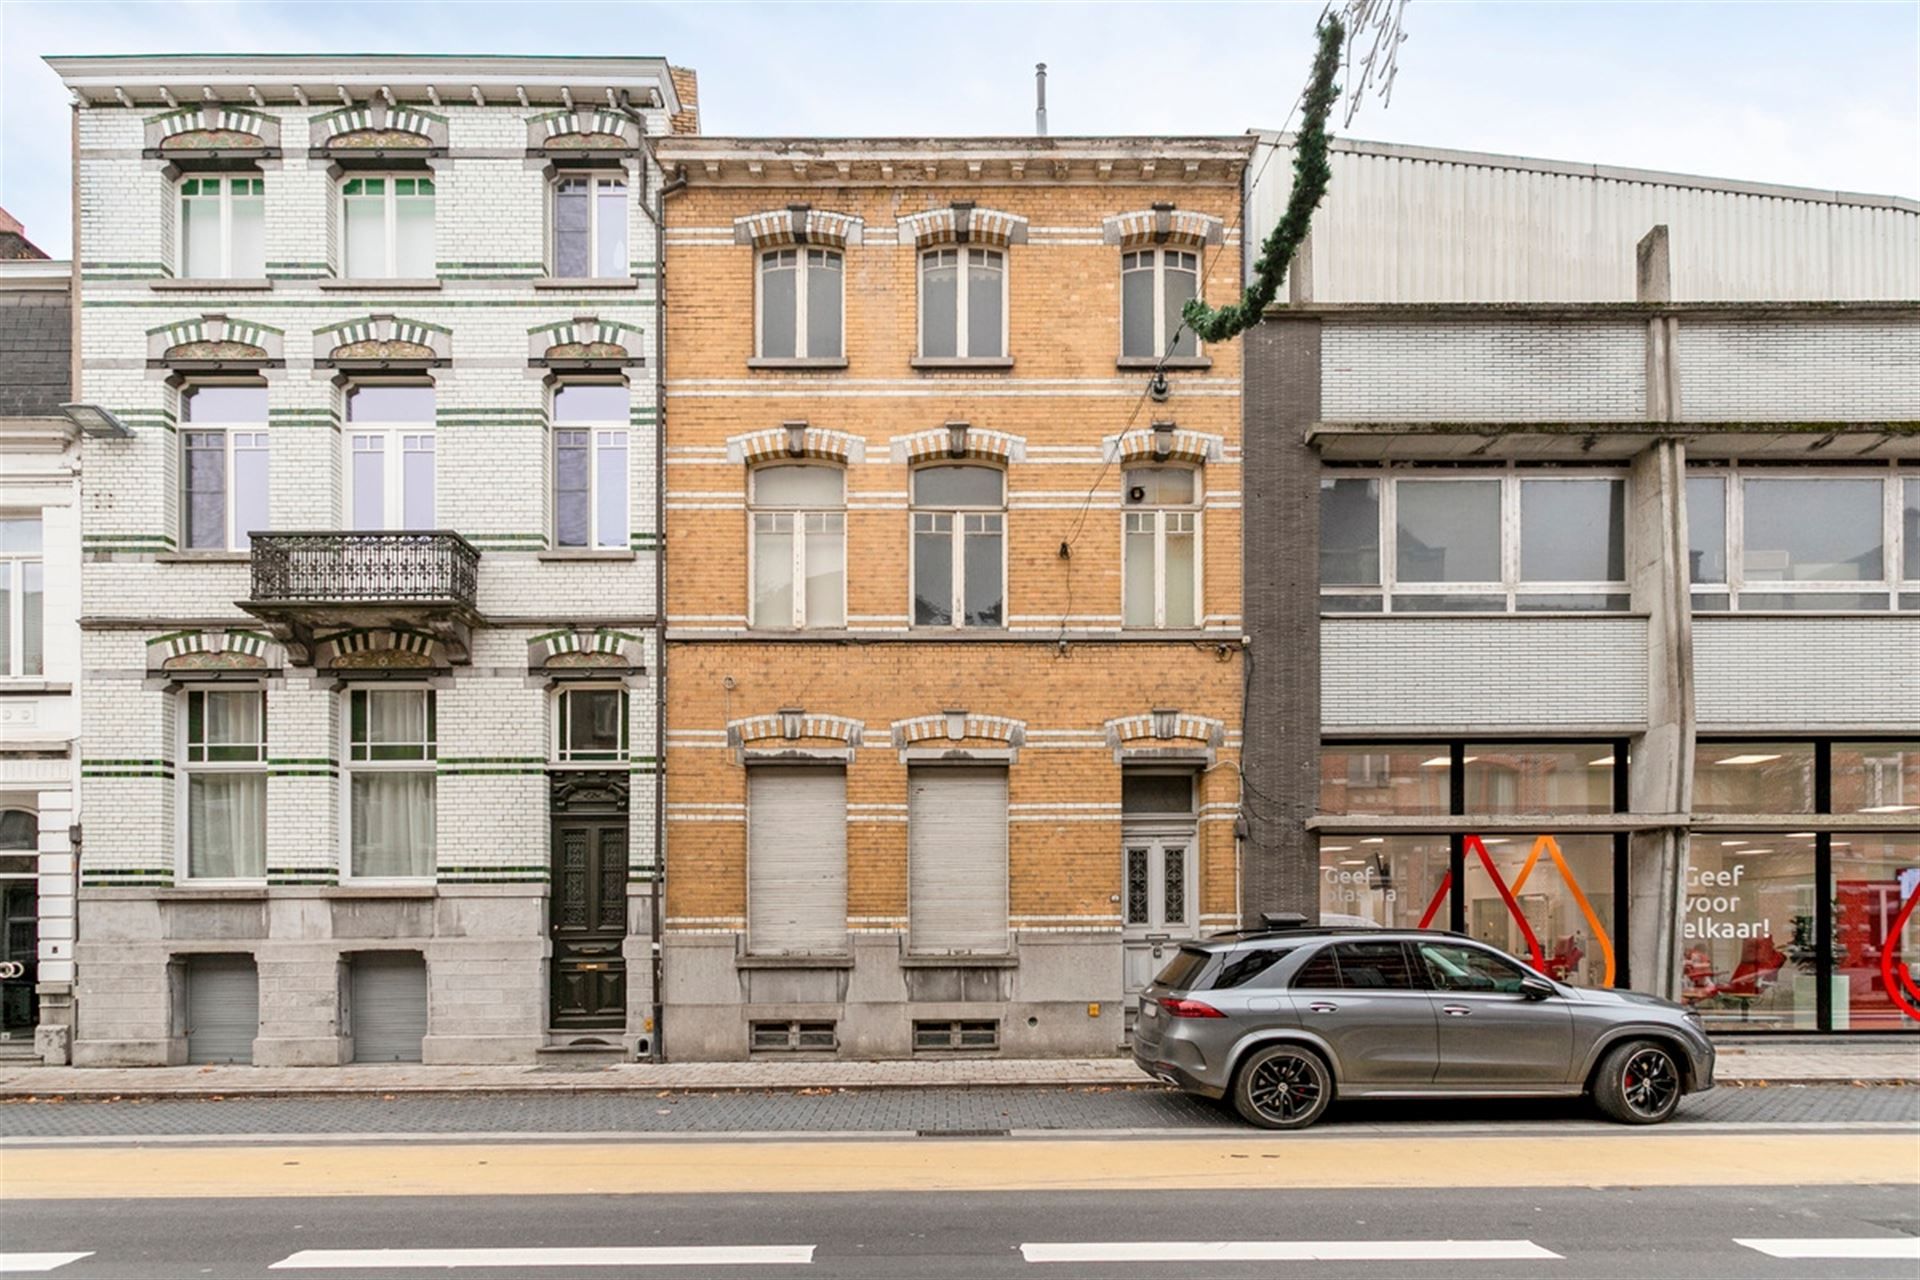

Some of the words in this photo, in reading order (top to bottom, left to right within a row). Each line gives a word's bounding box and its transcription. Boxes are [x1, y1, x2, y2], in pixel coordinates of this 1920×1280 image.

[1325, 866, 1374, 884] Geef
[1687, 865, 1744, 886] Geef
[1686, 896, 1740, 913] voor
[1684, 917, 1769, 939] elkaar!
